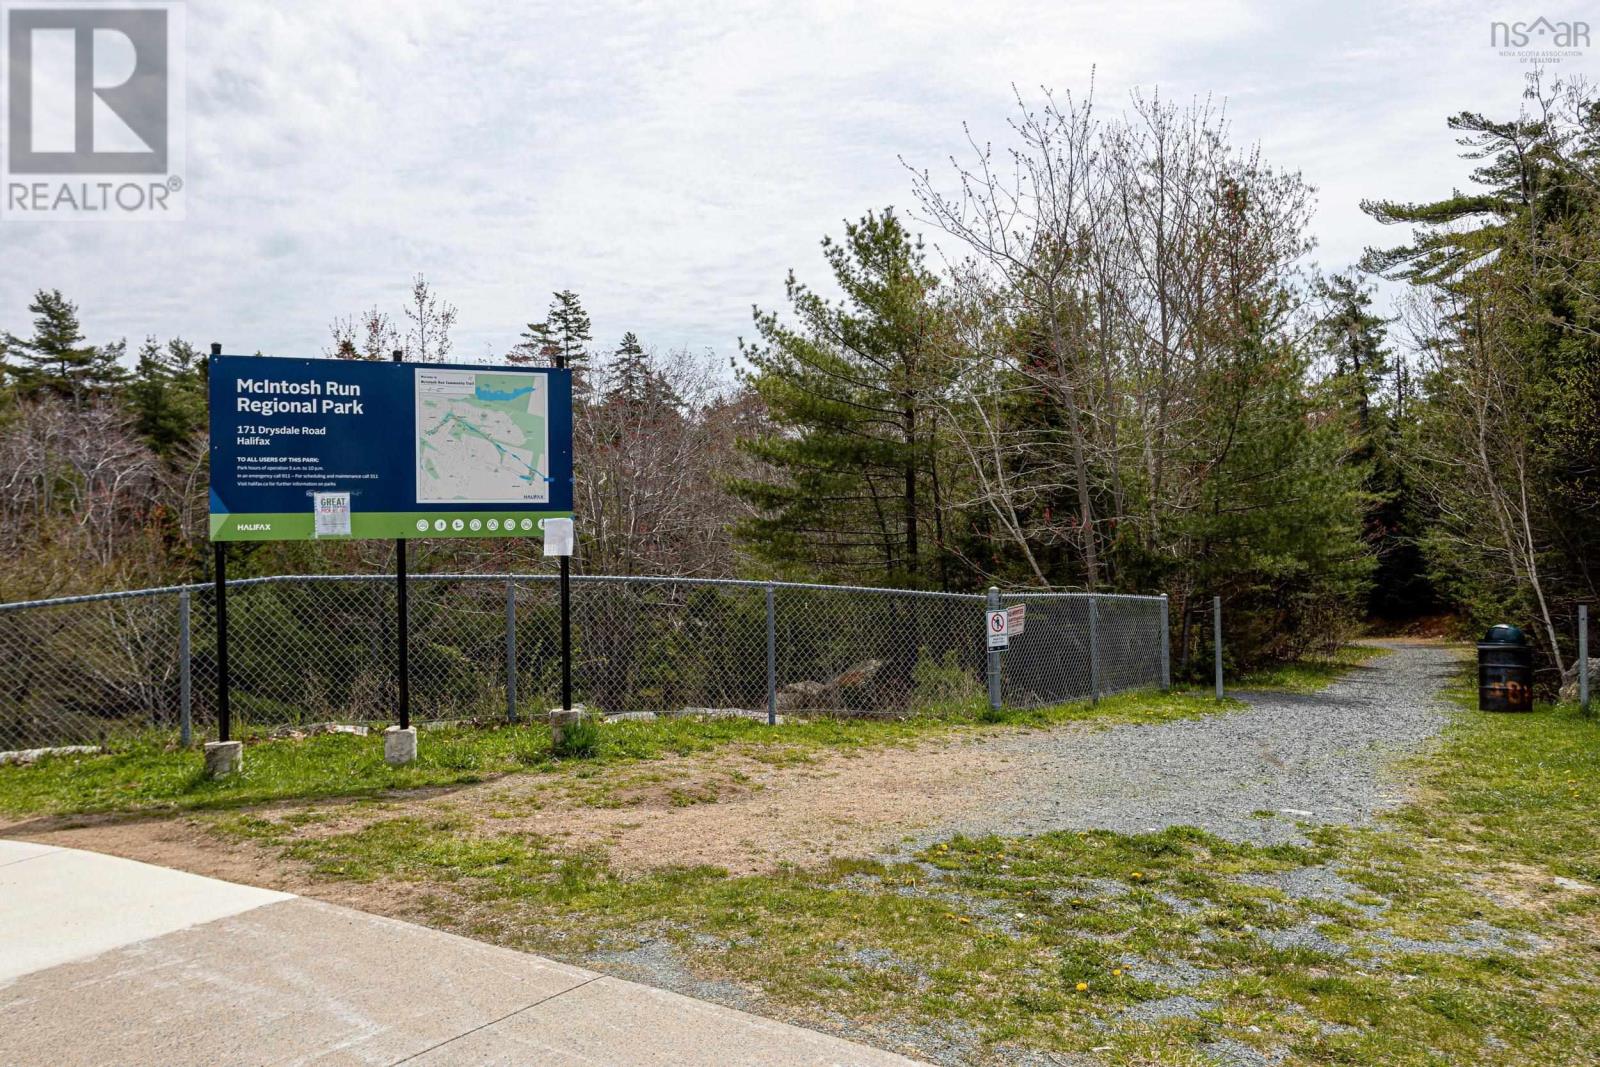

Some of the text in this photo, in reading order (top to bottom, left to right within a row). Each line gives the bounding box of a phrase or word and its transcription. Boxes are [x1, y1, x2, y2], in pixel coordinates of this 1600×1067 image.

[237, 379, 361, 396] McIntosh Run
[237, 397, 364, 416] Regional Park
[237, 426, 326, 436] 171 Drysdale Road
[237, 437, 271, 446] Halifax
[320, 497, 346, 506] GREAT
